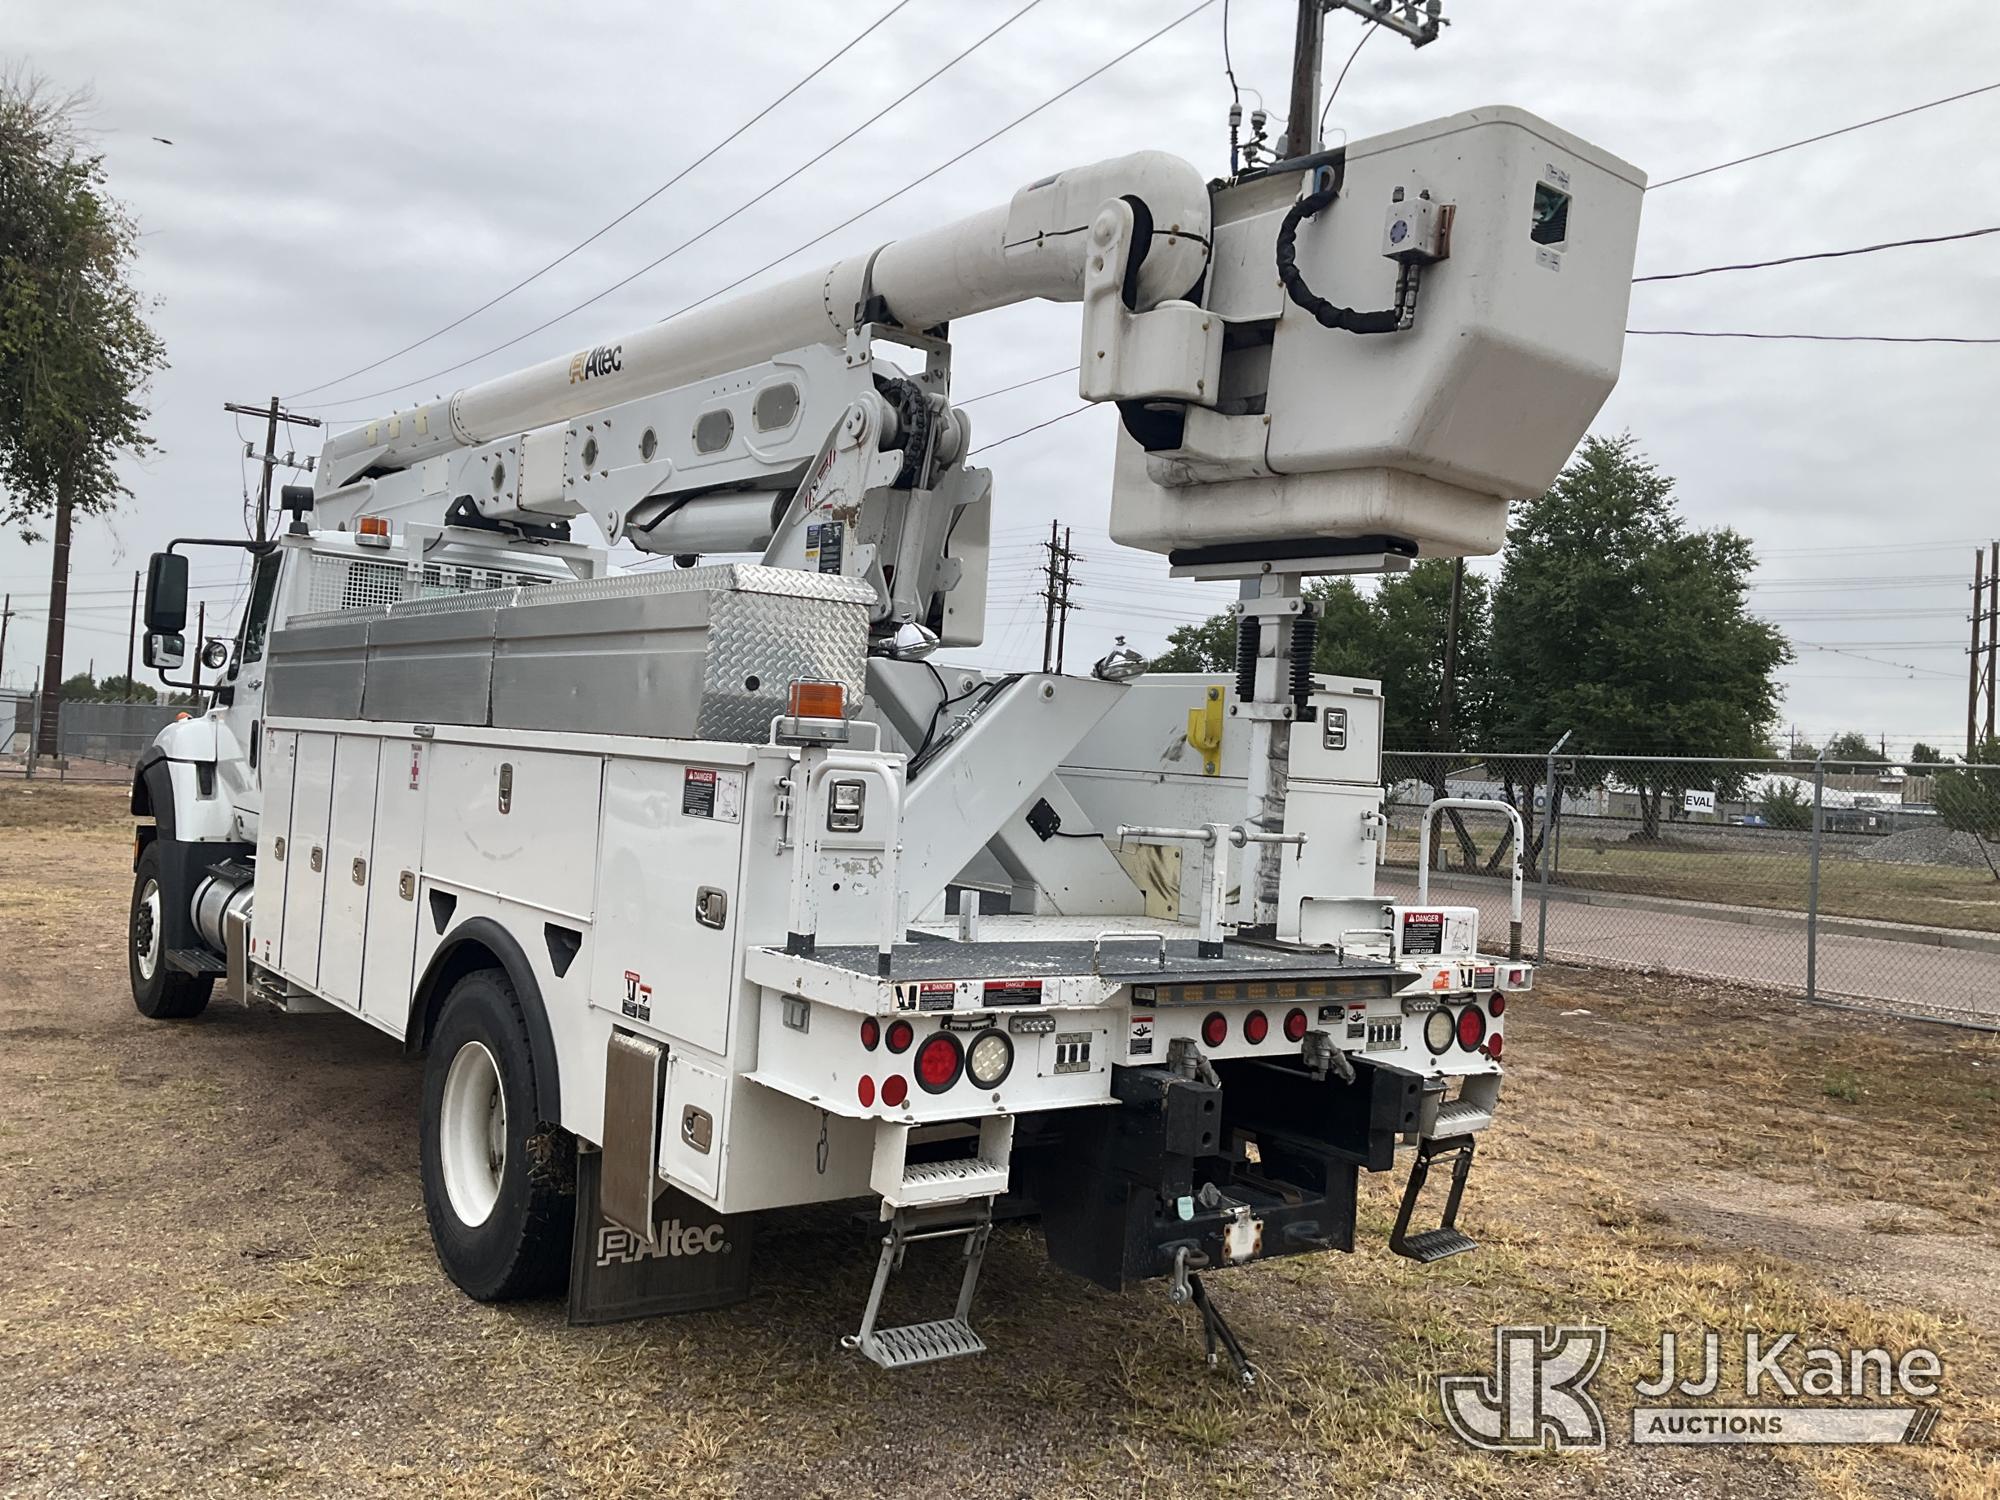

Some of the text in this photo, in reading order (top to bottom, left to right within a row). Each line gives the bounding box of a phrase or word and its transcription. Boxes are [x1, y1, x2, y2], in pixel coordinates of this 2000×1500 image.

[585, 345, 622, 380] Altec
[1685, 795, 1713, 808] EVAL
[1415, 914, 1439, 923] DANGER
[634, 1219, 724, 1262] Altec
